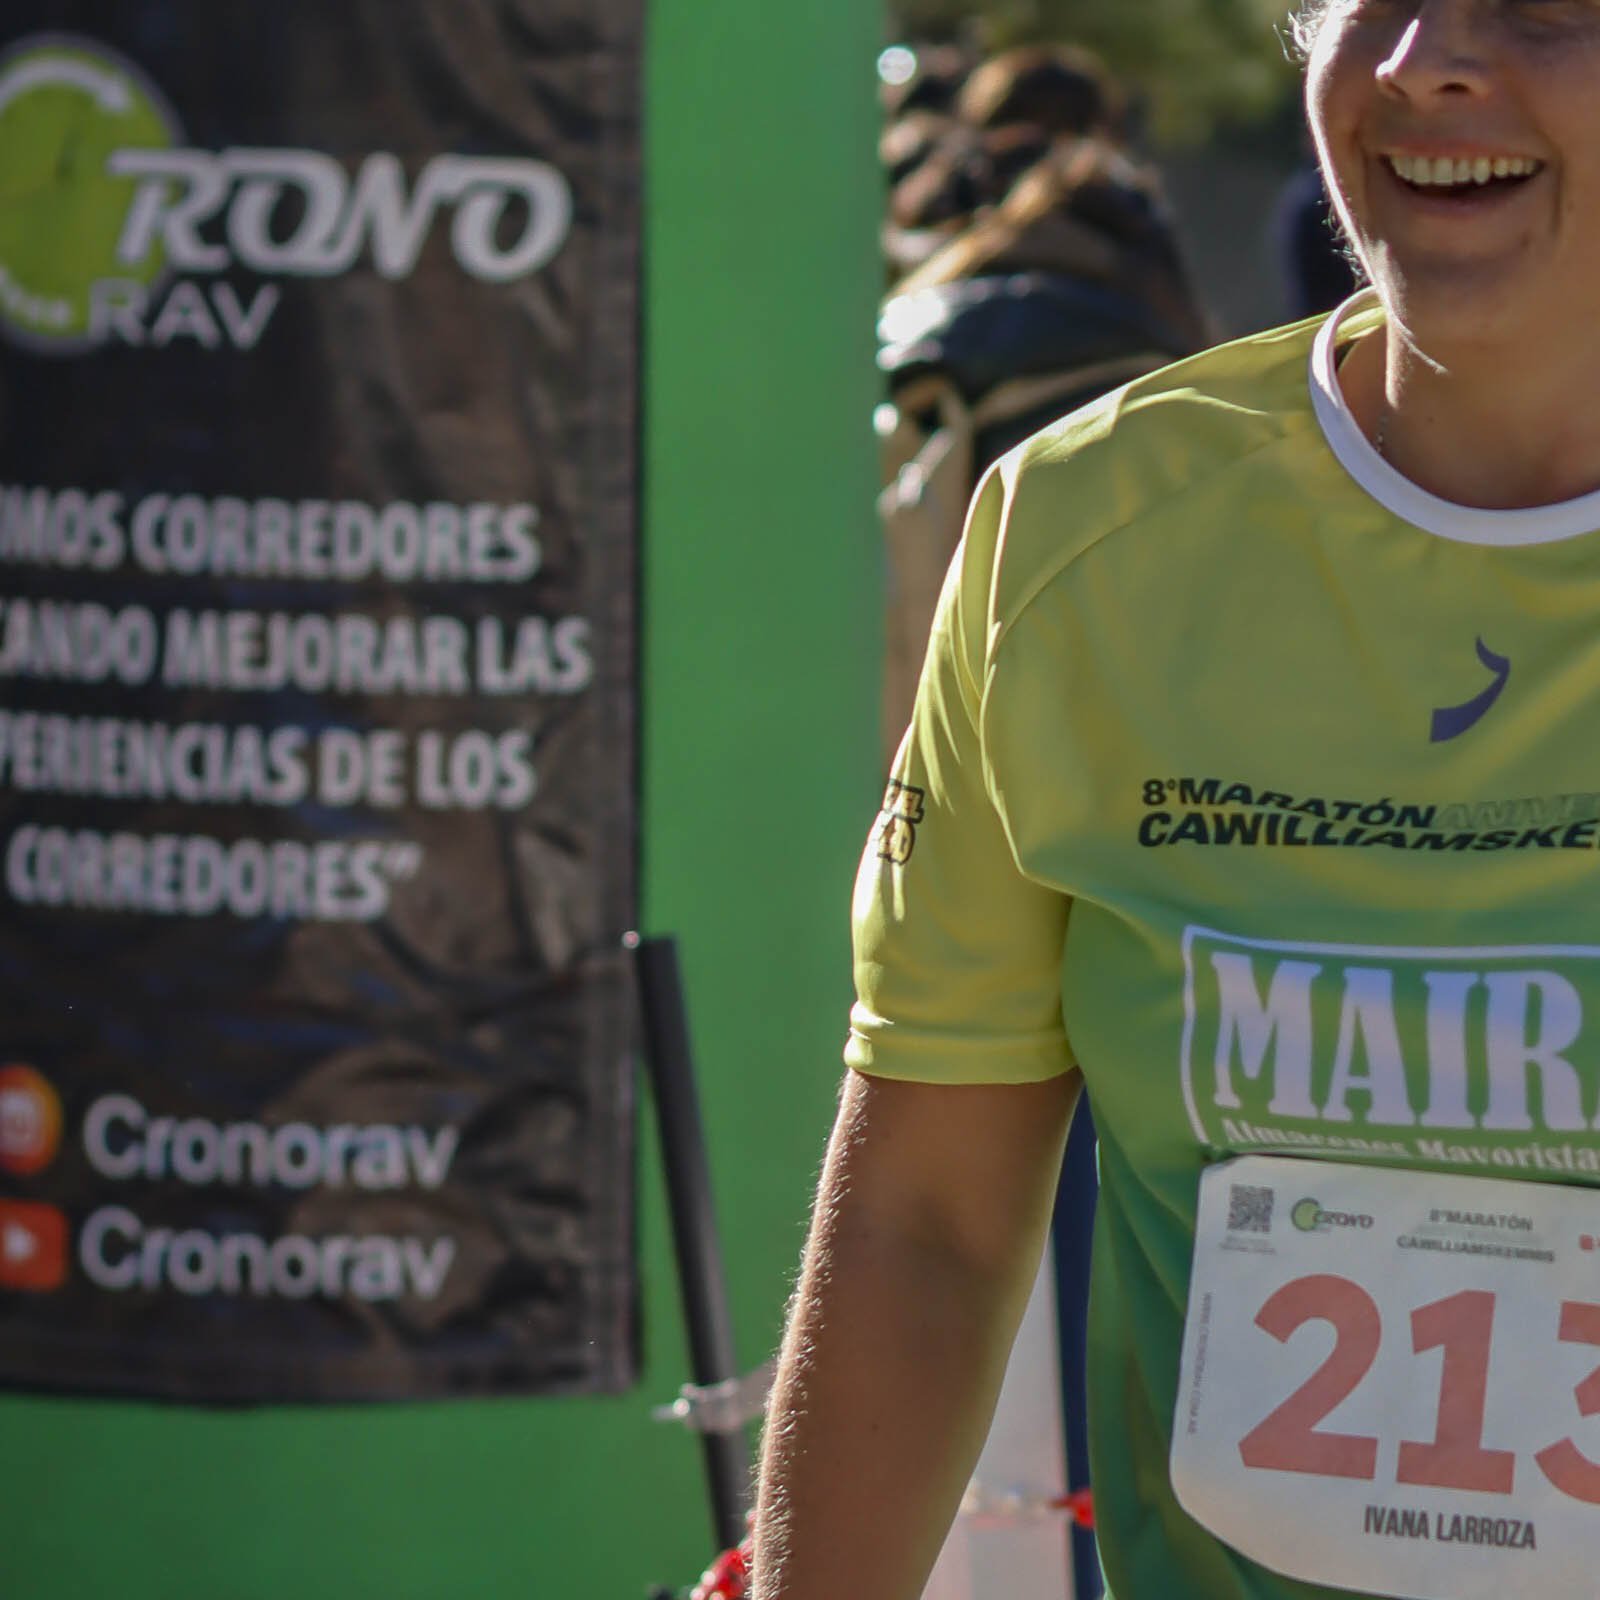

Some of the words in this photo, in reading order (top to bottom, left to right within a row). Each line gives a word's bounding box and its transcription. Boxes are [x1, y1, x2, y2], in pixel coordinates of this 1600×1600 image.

[88, 277, 282, 350] RAV
[130, 492, 542, 582] CORREDORES
[162, 610, 471, 693] MEJORAR
[474, 616, 594, 693] LAS
[317, 729, 407, 808] DE
[416, 730, 535, 811] LOS
[83, 1093, 460, 1189] Cronorav
[78, 1205, 456, 1301] Cronorav
[1364, 1503, 1430, 1540] IVANA
[1436, 1511, 1538, 1550] LARROZA
